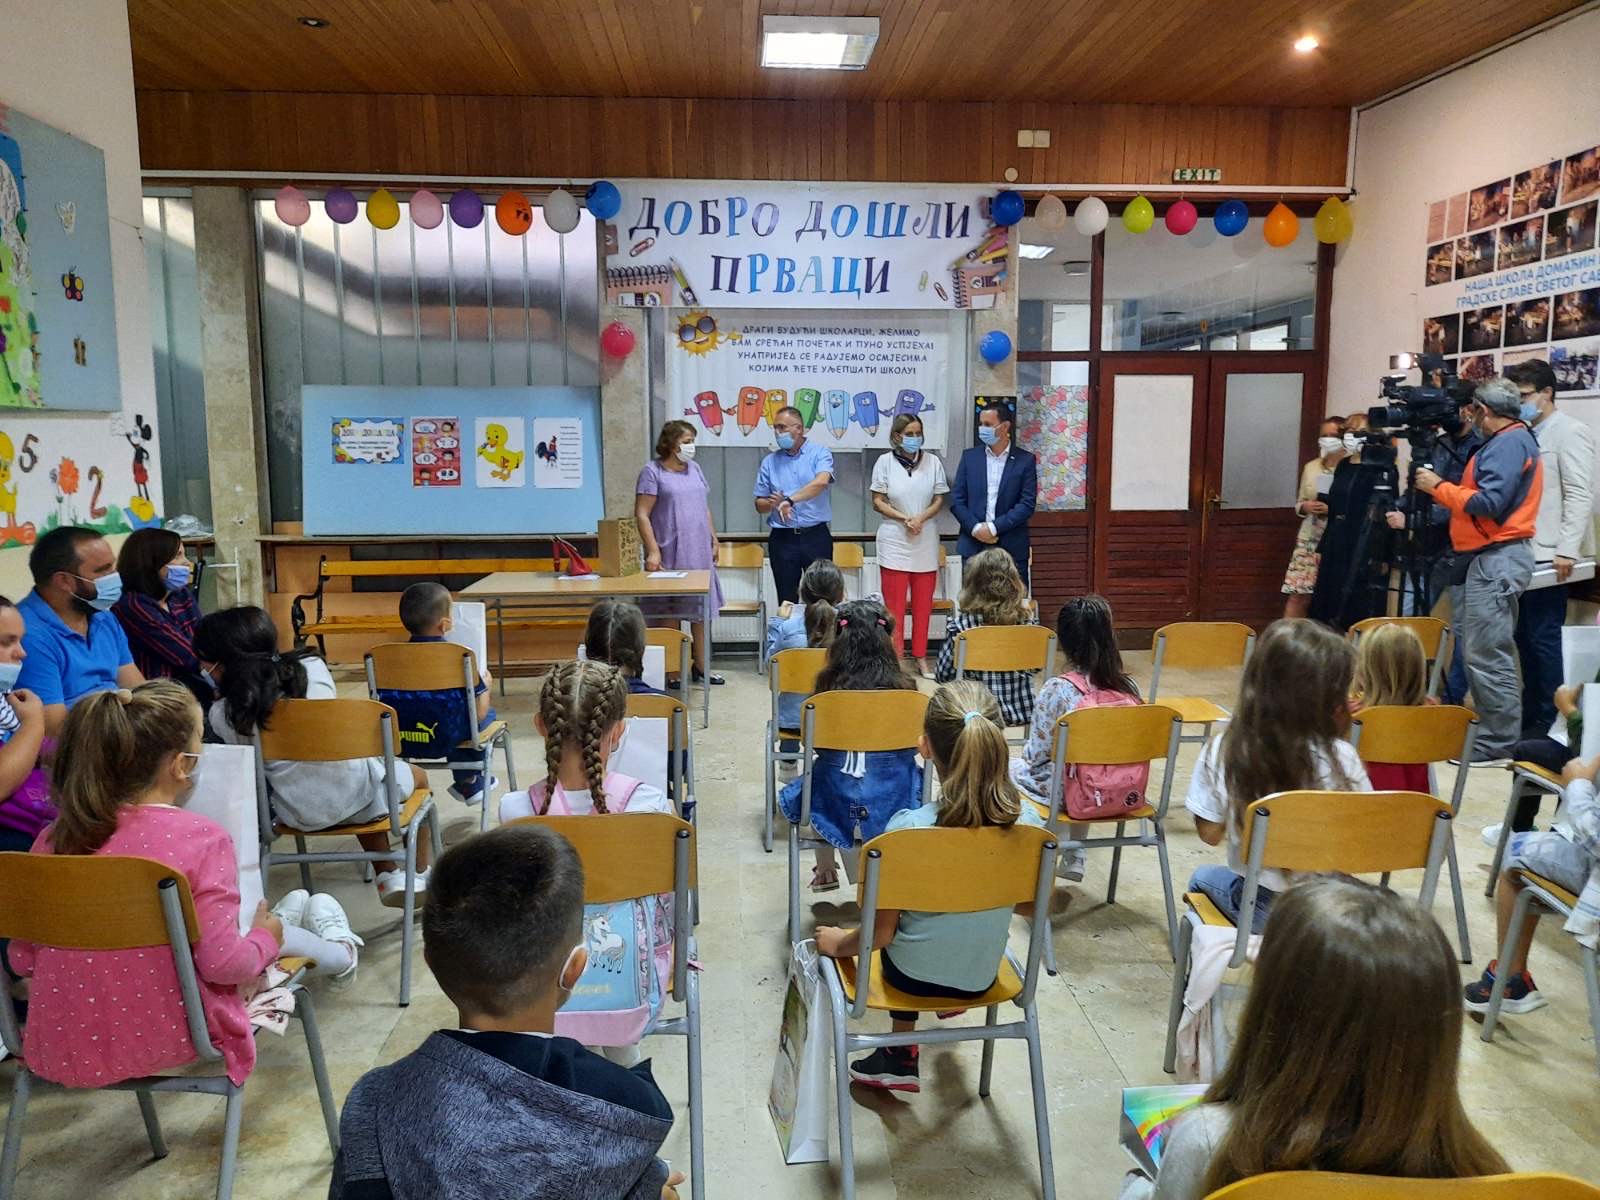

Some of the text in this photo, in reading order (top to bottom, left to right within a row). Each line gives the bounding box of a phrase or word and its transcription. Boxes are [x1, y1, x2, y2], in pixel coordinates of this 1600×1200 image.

[1179, 169, 1217, 180] EXIT
[628, 196, 971, 242] ДОБРО ДОШЛИ
[710, 253, 890, 300] ПРВАЦИ
[1465, 278, 1493, 293] НАША
[1496, 270, 1533, 286] ШКОЛА
[1501, 284, 1533, 300] СЛАВЕ
[1536, 275, 1576, 293] СВЕТОГ
[742, 325, 920, 337] ДРАГИ БУДУЋИ ШКОЛАРЦИ, ЖЕЛИМО
[755, 338, 793, 348] СРЕЋАН
[797, 339, 842, 348] ПОЧЕТАК
[845, 340, 852, 348] И
[855, 340, 883, 349] ПУНО
[887, 341, 934, 350] УСПЈЕХА!
[737, 351, 928, 362] УНАПРИЈЕД СЕ РАДУЈЕМО ОСМЈЕСИМА
[748, 364, 916, 375] КОЈИМА ЋЕТЕ УЉЕПШАТИ ШКОЛУ!
[19, 433, 40, 473] 5
[87, 465, 108, 520] 2
